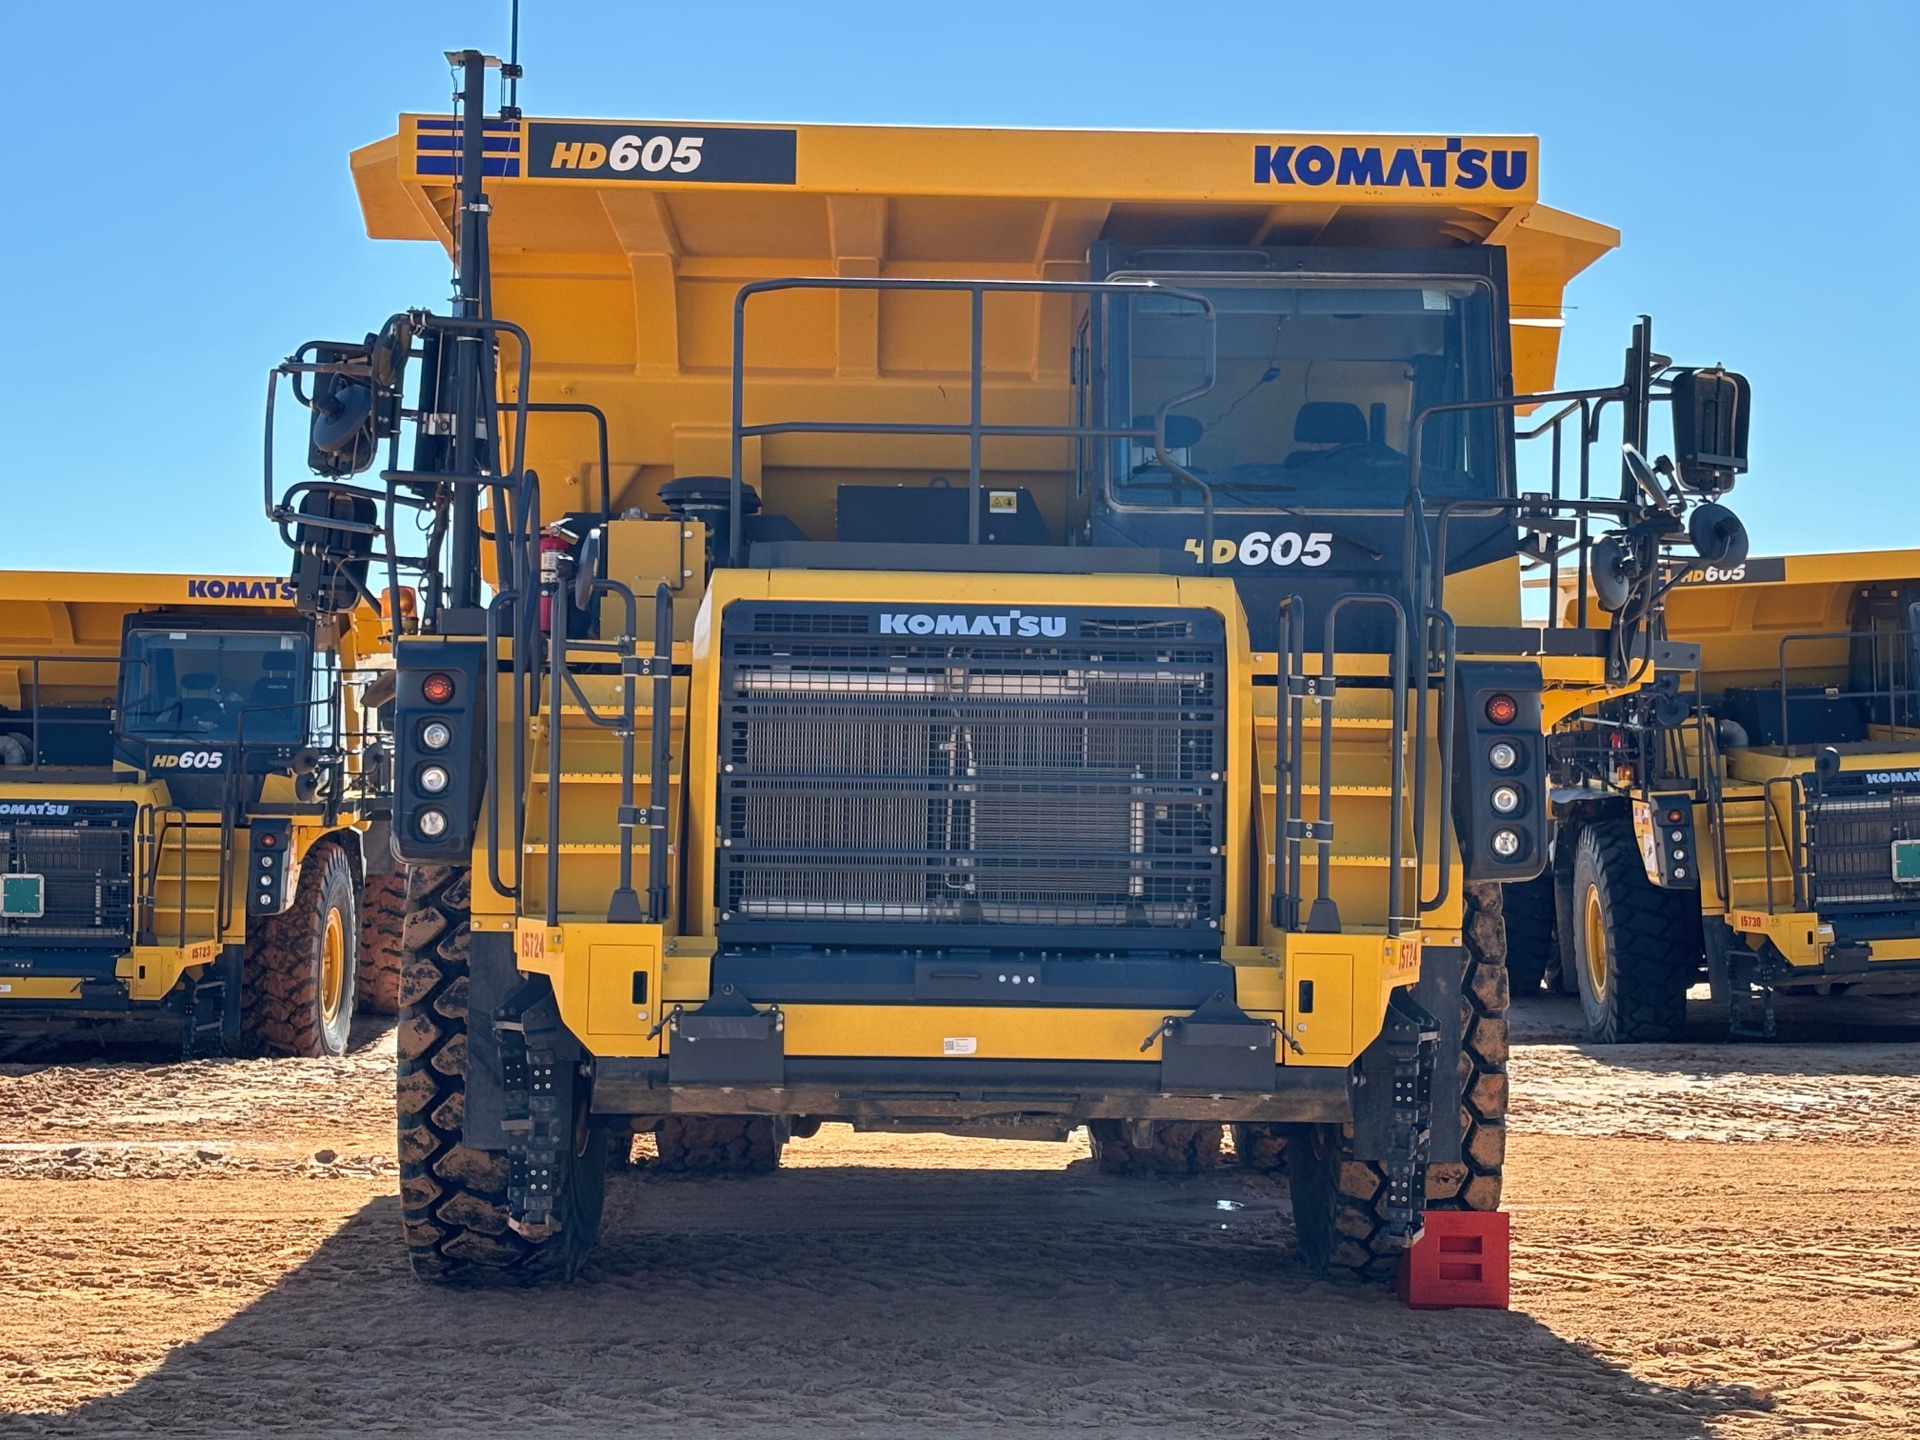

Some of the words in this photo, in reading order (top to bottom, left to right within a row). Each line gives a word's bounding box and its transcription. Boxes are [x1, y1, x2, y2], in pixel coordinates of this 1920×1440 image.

[550, 134, 704, 173] HD605
[1254, 138, 1527, 189] KOMATSU
[188, 577, 294, 600] KOMATS
[880, 610, 1067, 637] KOMATSU
[152, 751, 223, 769] HD605
[1866, 770, 1920, 784] KOMAT
[0, 802, 69, 815] OMATSU
